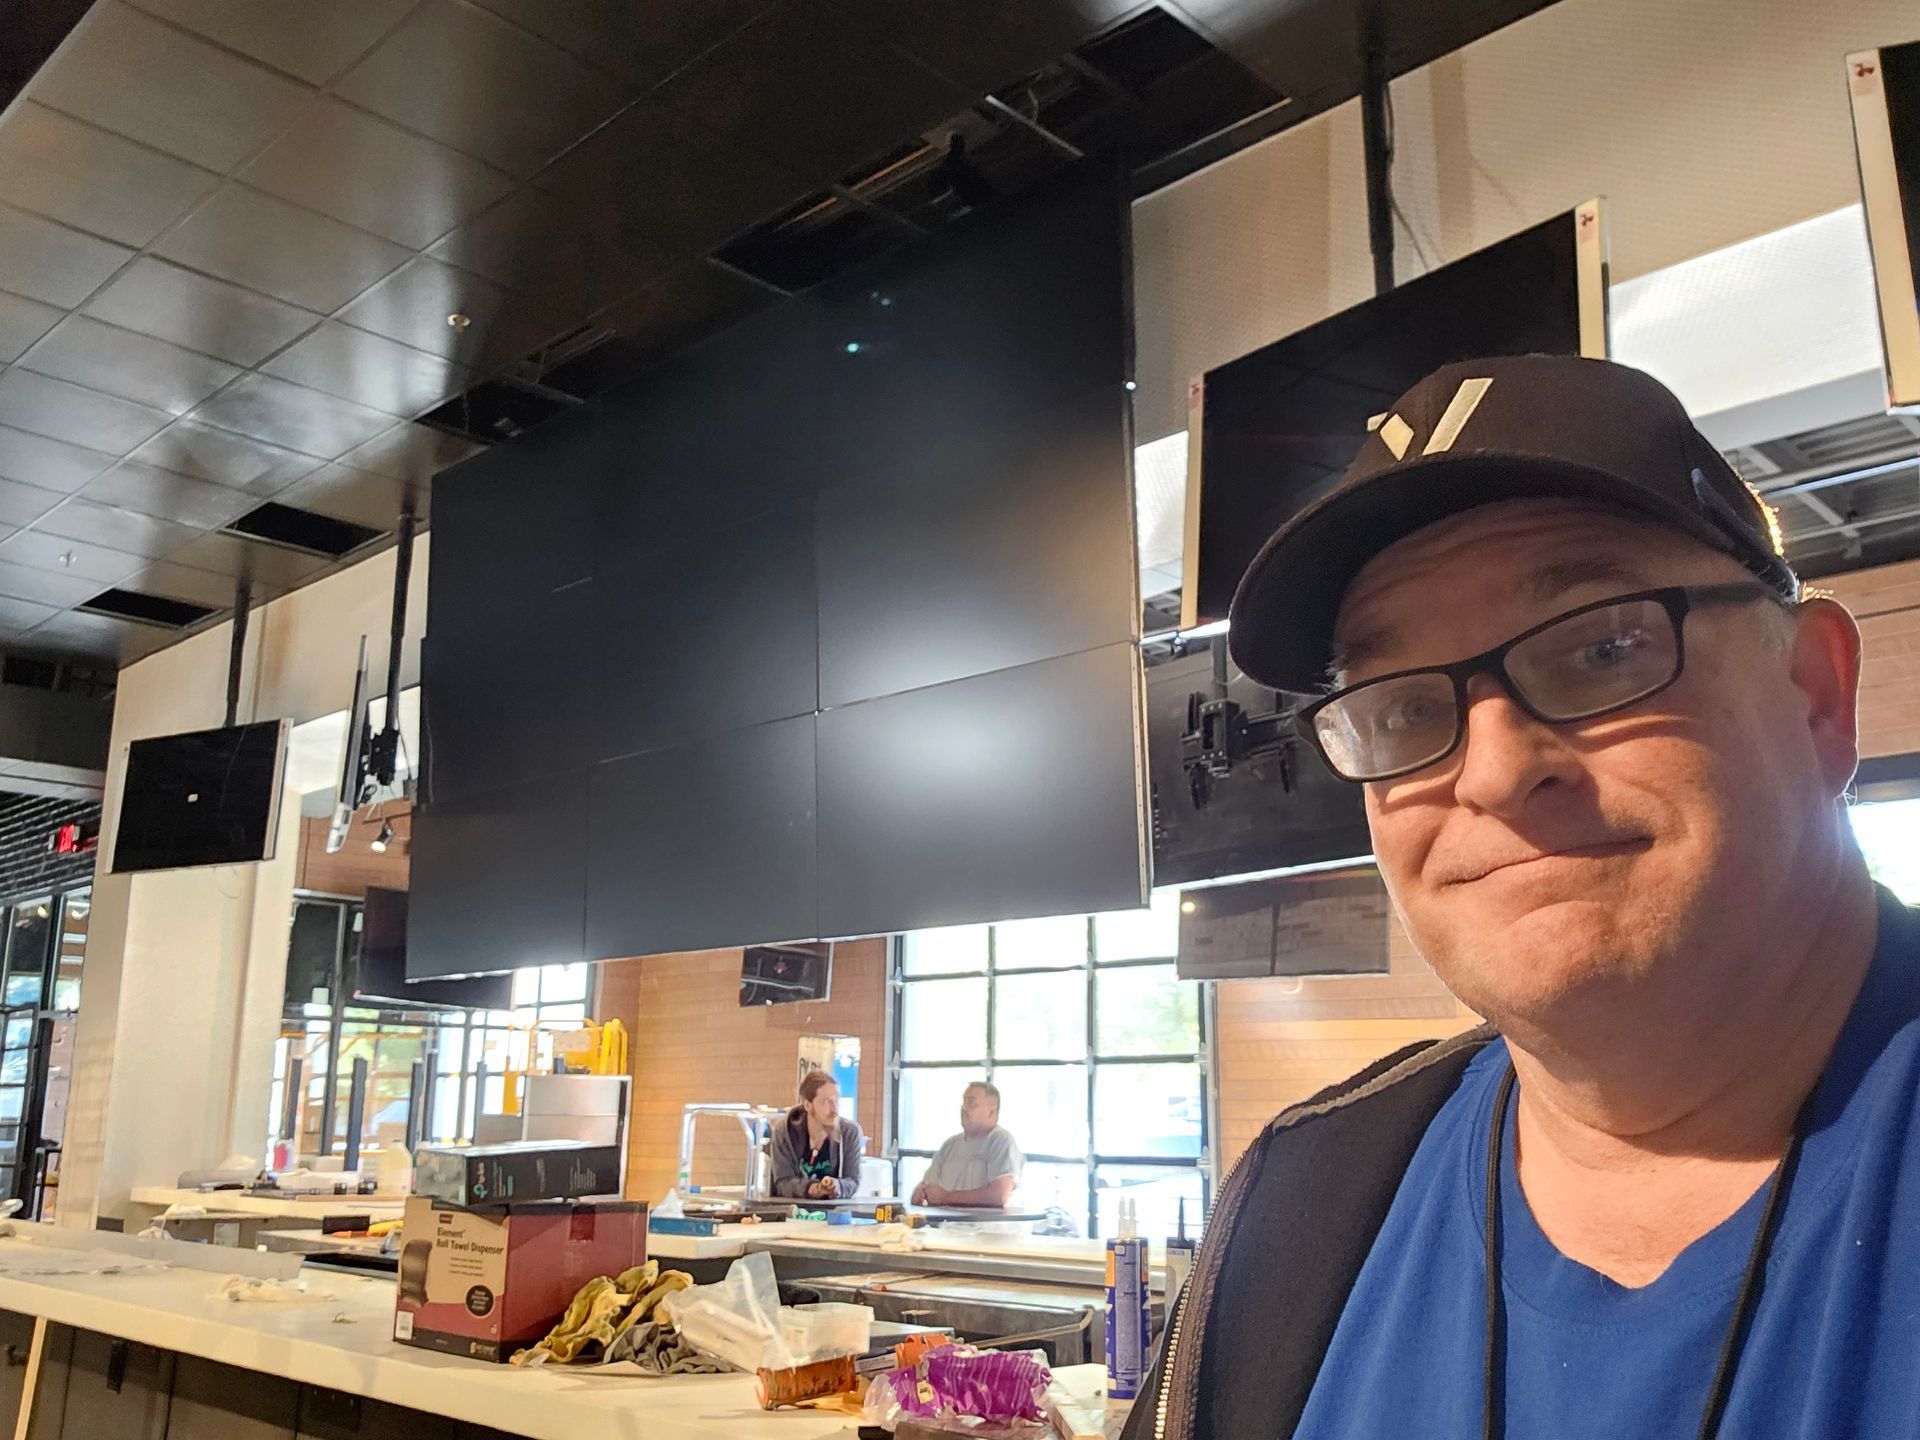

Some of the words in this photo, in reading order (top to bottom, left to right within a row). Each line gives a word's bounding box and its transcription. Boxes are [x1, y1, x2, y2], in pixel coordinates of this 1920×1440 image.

[436, 1239, 449, 1248] Roll
[451, 1240, 469, 1251] Towel
[471, 1242, 504, 1255] Dispenser
